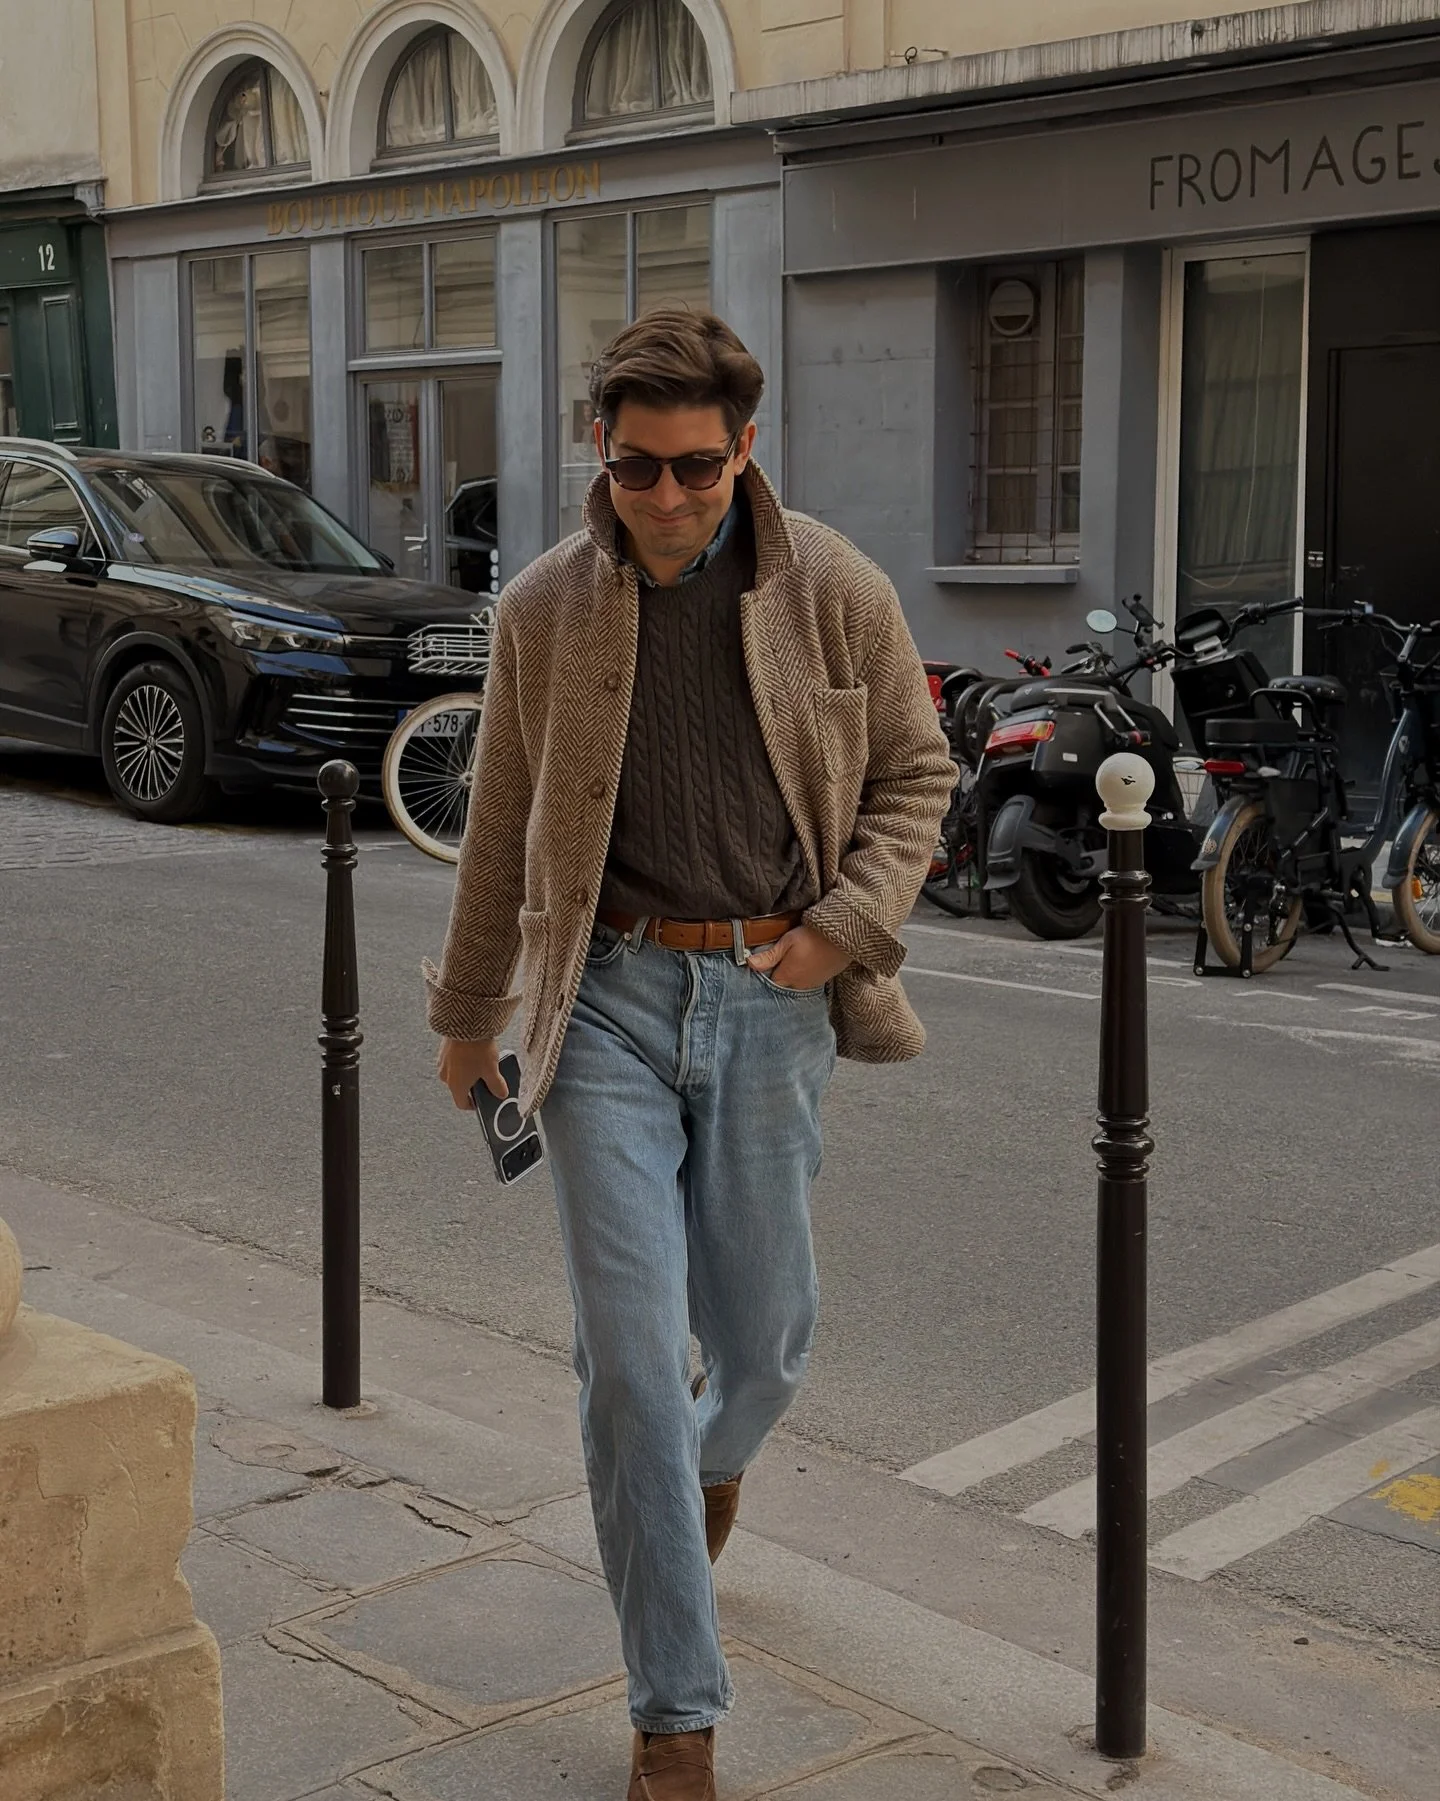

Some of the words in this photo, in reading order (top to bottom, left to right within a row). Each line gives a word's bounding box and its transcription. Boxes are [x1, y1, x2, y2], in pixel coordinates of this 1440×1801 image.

[267, 186, 416, 237] BOUTIQUE
[424, 161, 600, 217] NAPOLEON
[38, 243, 55, 271] 12
